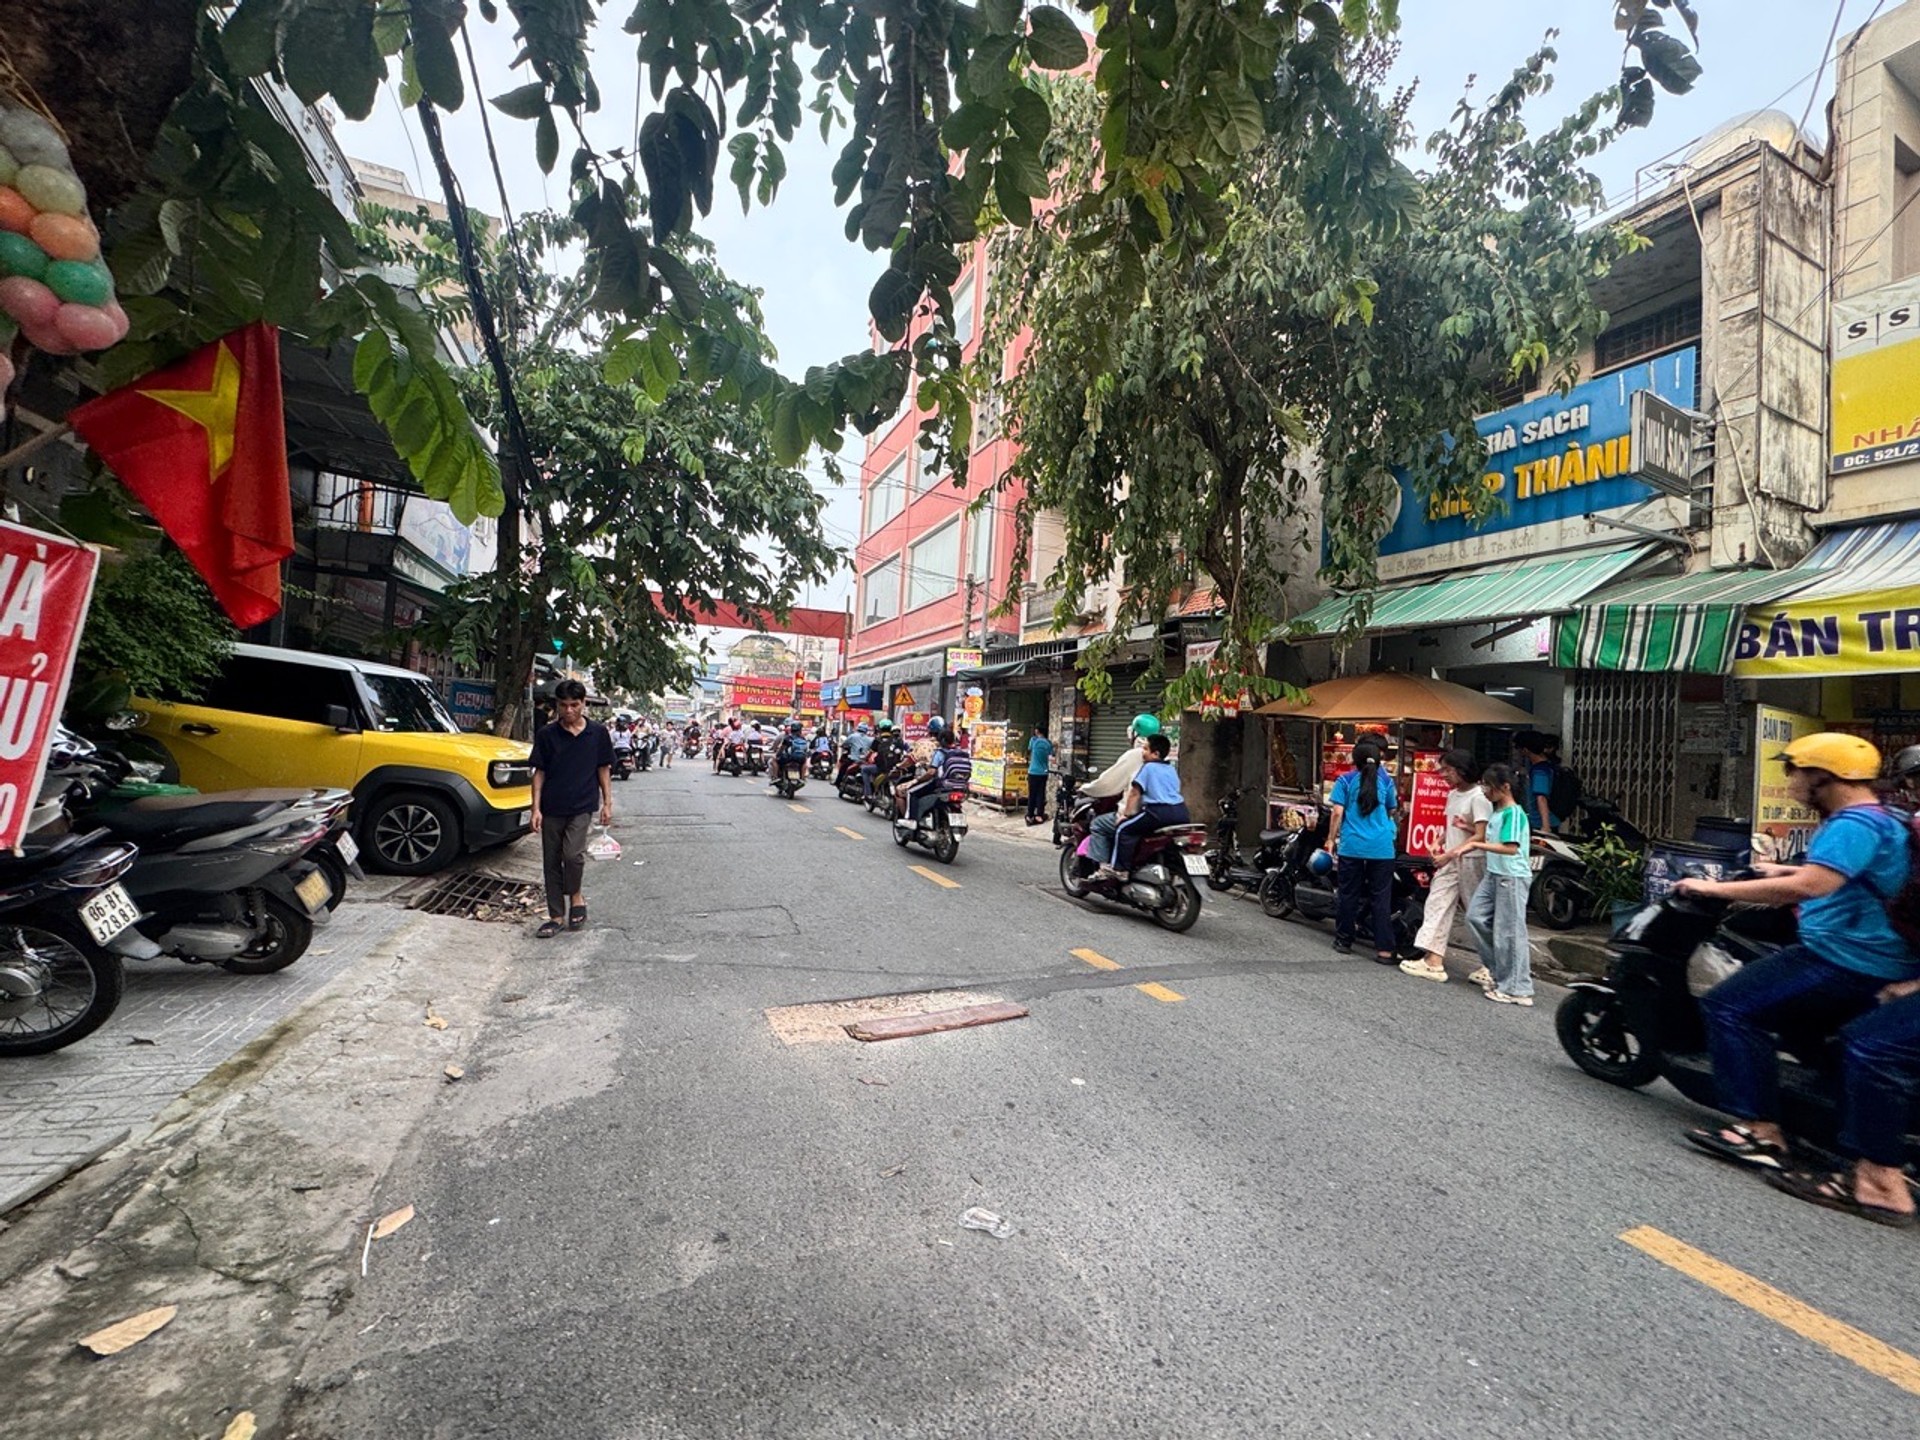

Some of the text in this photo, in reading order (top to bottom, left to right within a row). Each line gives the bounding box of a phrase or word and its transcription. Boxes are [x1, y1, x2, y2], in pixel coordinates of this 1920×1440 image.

[1645, 410, 1691, 481] NHÀ SÁCH
[1734, 612, 1841, 661] BÁN
